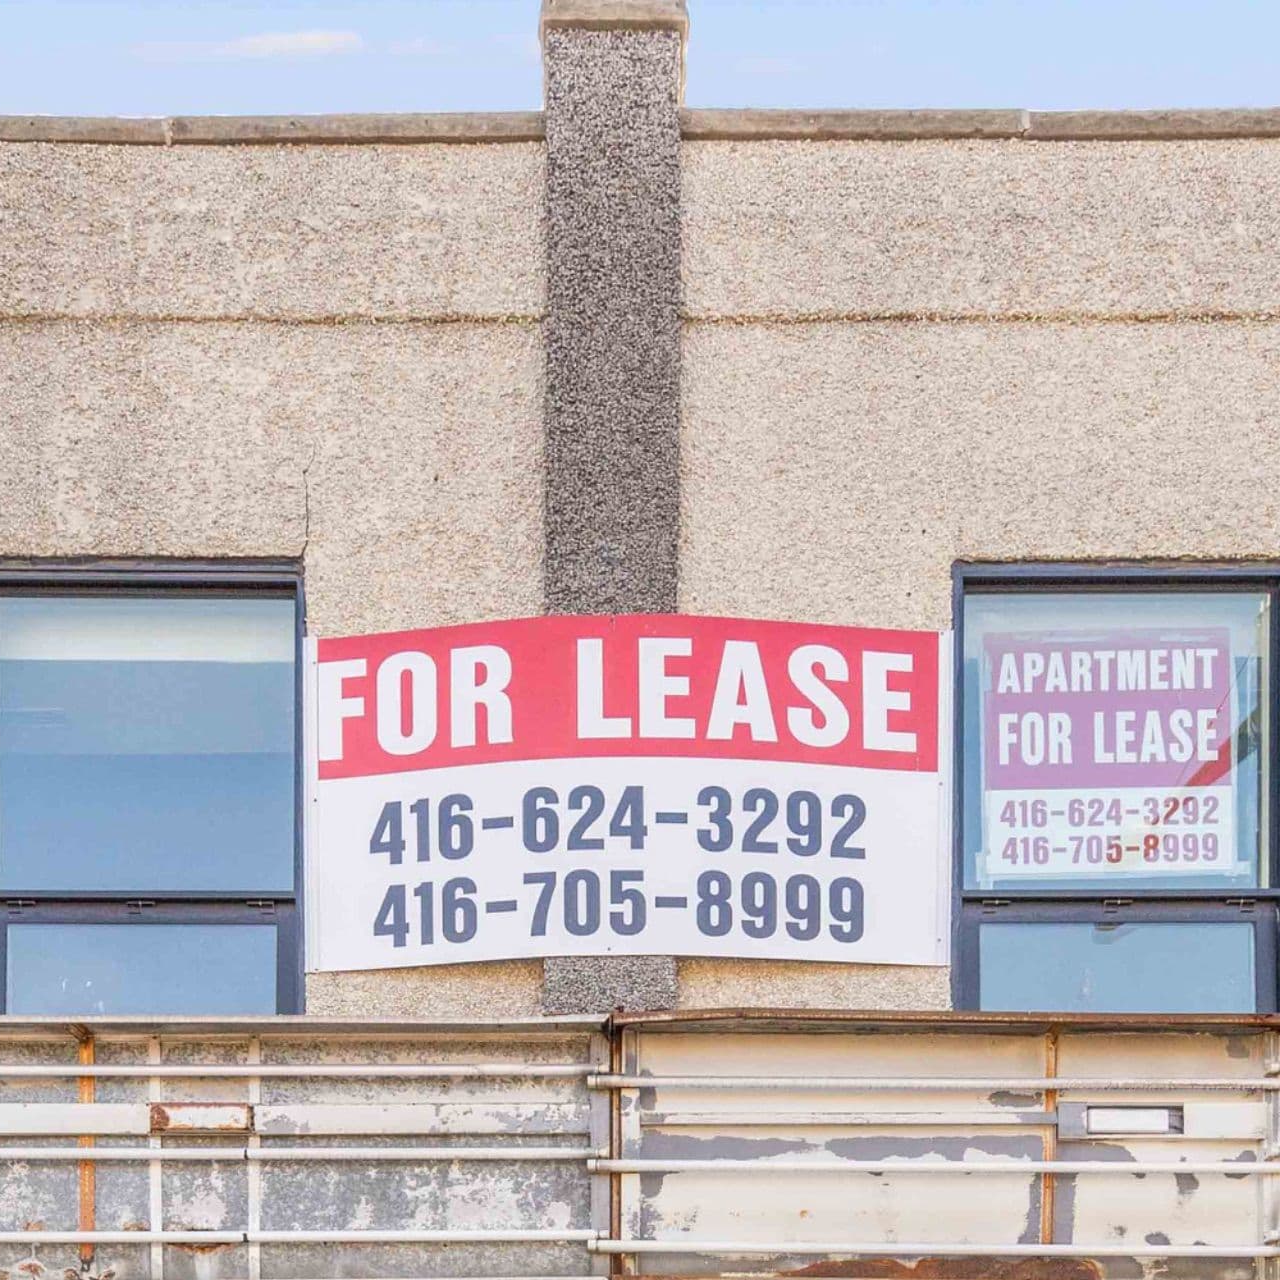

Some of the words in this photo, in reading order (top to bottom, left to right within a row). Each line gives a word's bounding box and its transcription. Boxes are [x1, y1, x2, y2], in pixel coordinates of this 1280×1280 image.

[318, 643, 514, 762] FOR
[576, 637, 918, 754] LEASE
[998, 648, 1219, 694] APARTMENT
[998, 712, 1072, 766] FOR
[1093, 708, 1220, 764] LEASE
[368, 785, 868, 865] 416-624-3292
[999, 795, 1220, 828] 416-624-3292
[1001, 832, 1220, 866] 416-705-8999
[372, 869, 866, 948] 416-705-8999
